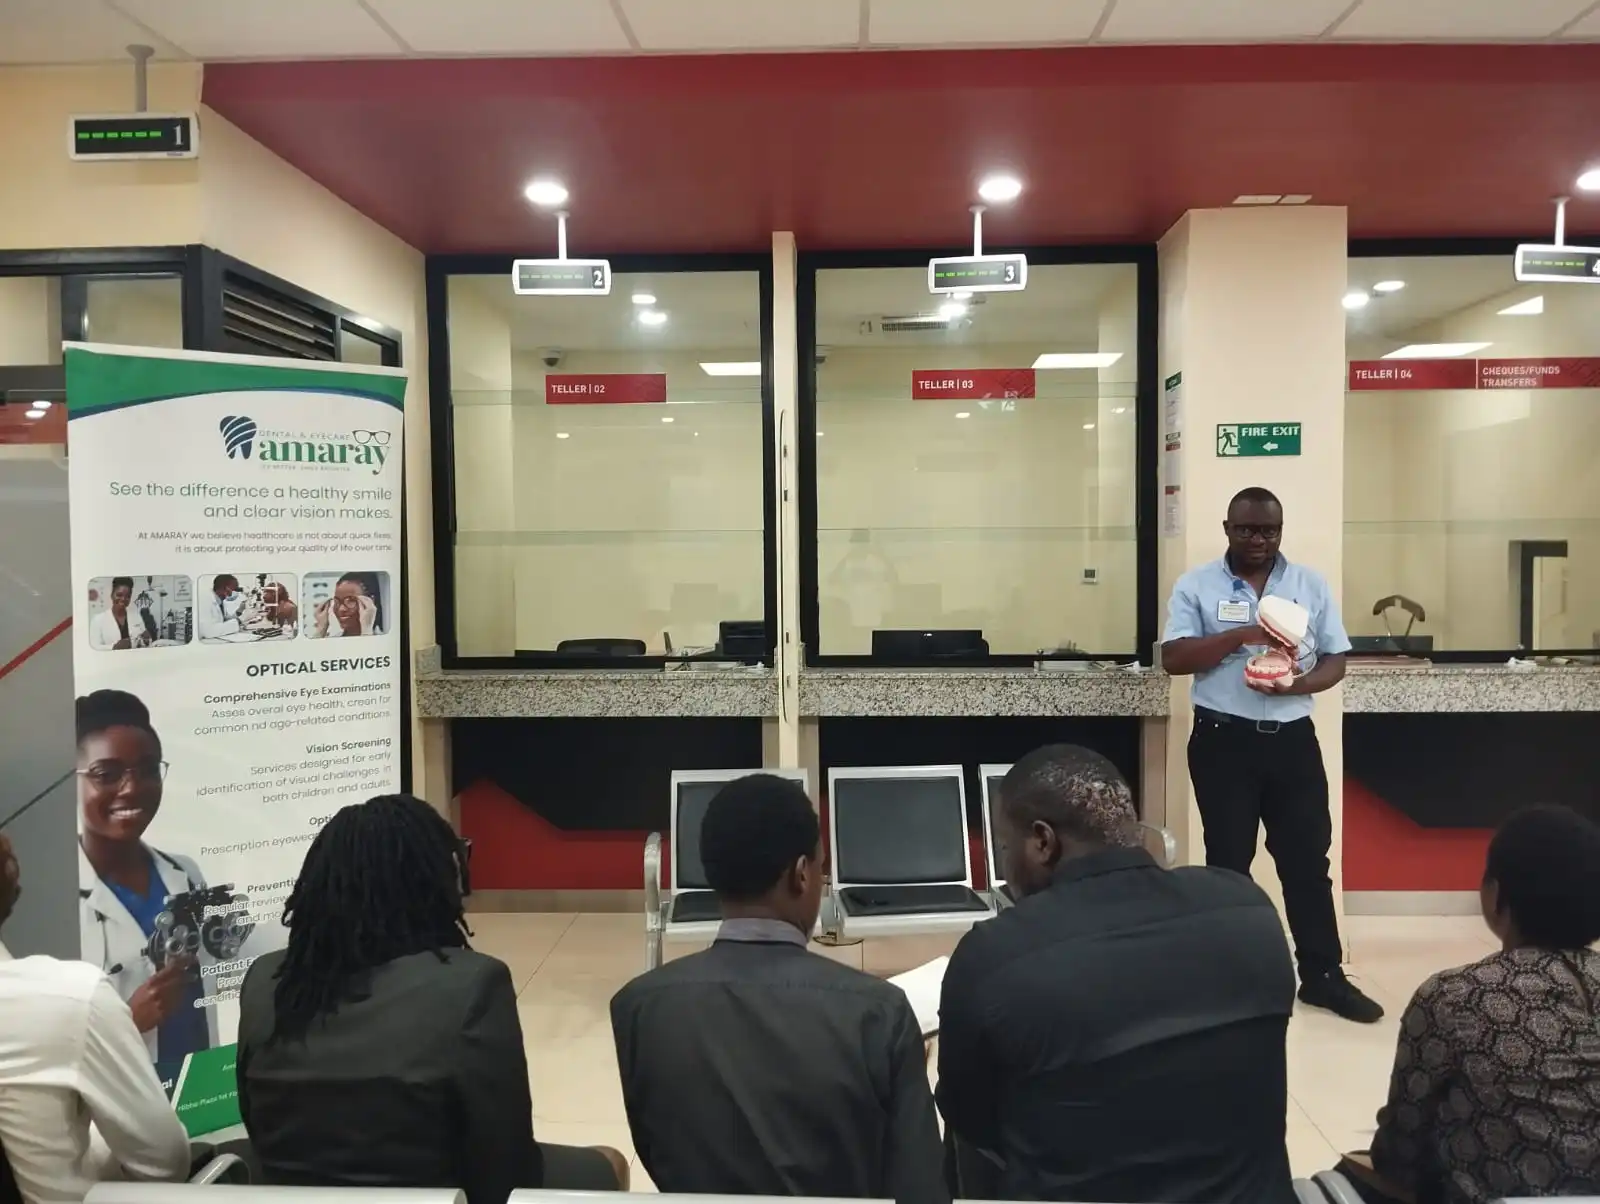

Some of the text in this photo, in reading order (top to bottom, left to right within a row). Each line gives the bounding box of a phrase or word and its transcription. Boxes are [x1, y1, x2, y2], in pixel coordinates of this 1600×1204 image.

[174, 124, 183, 145] 1
[1004, 265, 1015, 282] 3
[1592, 259, 1600, 275] 4
[593, 270, 603, 286] 2
[1356, 370, 1413, 379] TELLER 04
[1482, 366, 1560, 376] CHEQUES/FUNDS
[551, 384, 605, 394] TELLER 02
[918, 380, 973, 389] TELLER 03
[1482, 378, 1537, 387] TRANSFERS
[259, 430, 296, 438] DENTAL
[1241, 425, 1300, 437] FIRE EXIT
[259, 439, 392, 475] amaray
[110, 482, 392, 503] See the difference a healthy smile
[203, 504, 392, 519] and clear vision makes.
[138, 531, 147, 540] At
[150, 531, 188, 540] AMARAY
[207, 531, 242, 540] believe
[244, 531, 294, 540] healthcare
[305, 532, 320, 540] not
[321, 532, 347, 540] about
[184, 544, 192, 553] is
[194, 544, 222, 553] about
[225, 544, 274, 555] protecting
[276, 546, 297, 554] your
[298, 543, 328, 554] quality
[330, 543, 338, 551] of
[246, 655, 391, 677] OPTICAL SERVICES
[204, 682, 391, 704] Comprehensive Eye Examinations
[212, 709, 245, 718] Asses
[248, 704, 283, 716] overal
[286, 704, 306, 715] eye
[379, 695, 391, 703] for
[194, 723, 249, 735] common
[251, 721, 266, 731] nd
[269, 714, 336, 731] age-related
[305, 738, 391, 754] Vision Screening
[250, 751, 391, 775] Services designed for early
[196, 781, 273, 797] identification
[276, 777, 287, 787] of
[289, 773, 320, 785] visual
[323, 767, 380, 780] challenges
[263, 792, 289, 803] both
[291, 787, 334, 800] children
[337, 783, 358, 793] and
[309, 814, 333, 827] Opti
[201, 839, 269, 856] Prescription
[247, 877, 297, 893] Preventi
[204, 901, 250, 915] Regular
[236, 913, 260, 925] and
[201, 960, 245, 977] Patient
[218, 976, 244, 988] Prov
